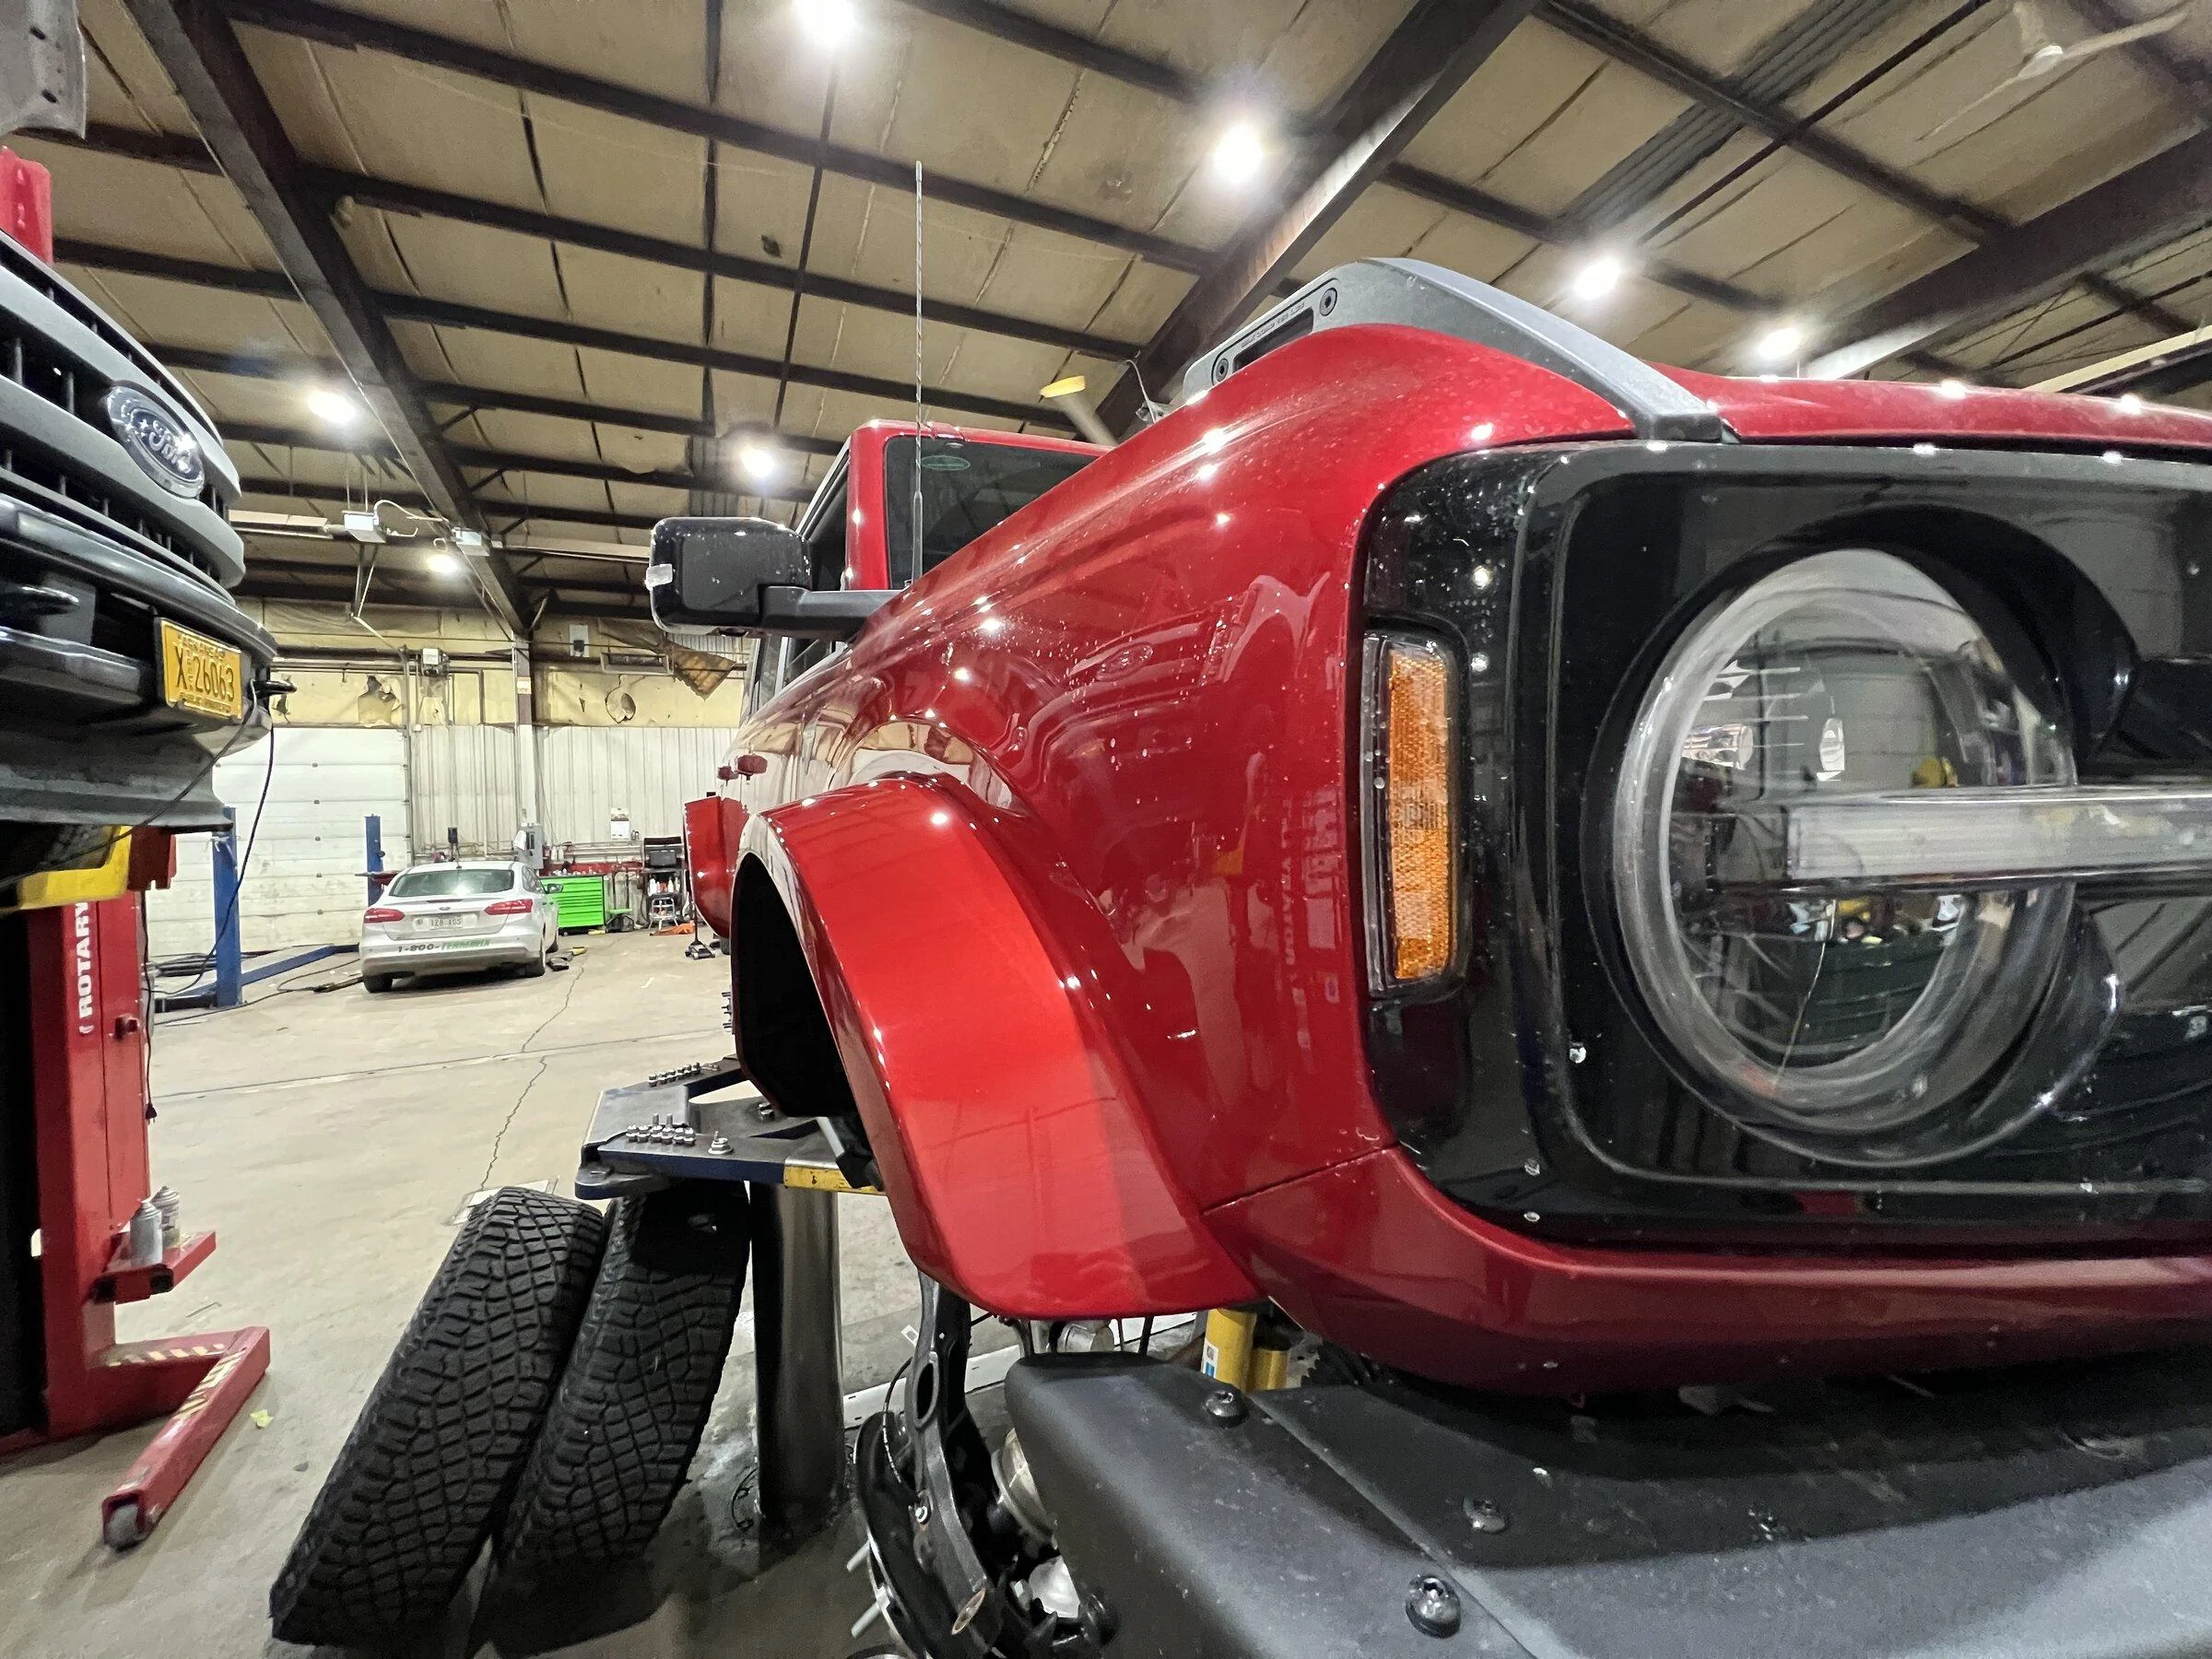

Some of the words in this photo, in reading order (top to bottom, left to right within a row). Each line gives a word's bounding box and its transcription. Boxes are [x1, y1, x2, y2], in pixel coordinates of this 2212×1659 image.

[174, 644, 188, 690] X
[192, 654, 235, 702] 26063
[75, 902, 93, 1019] ROTARY
